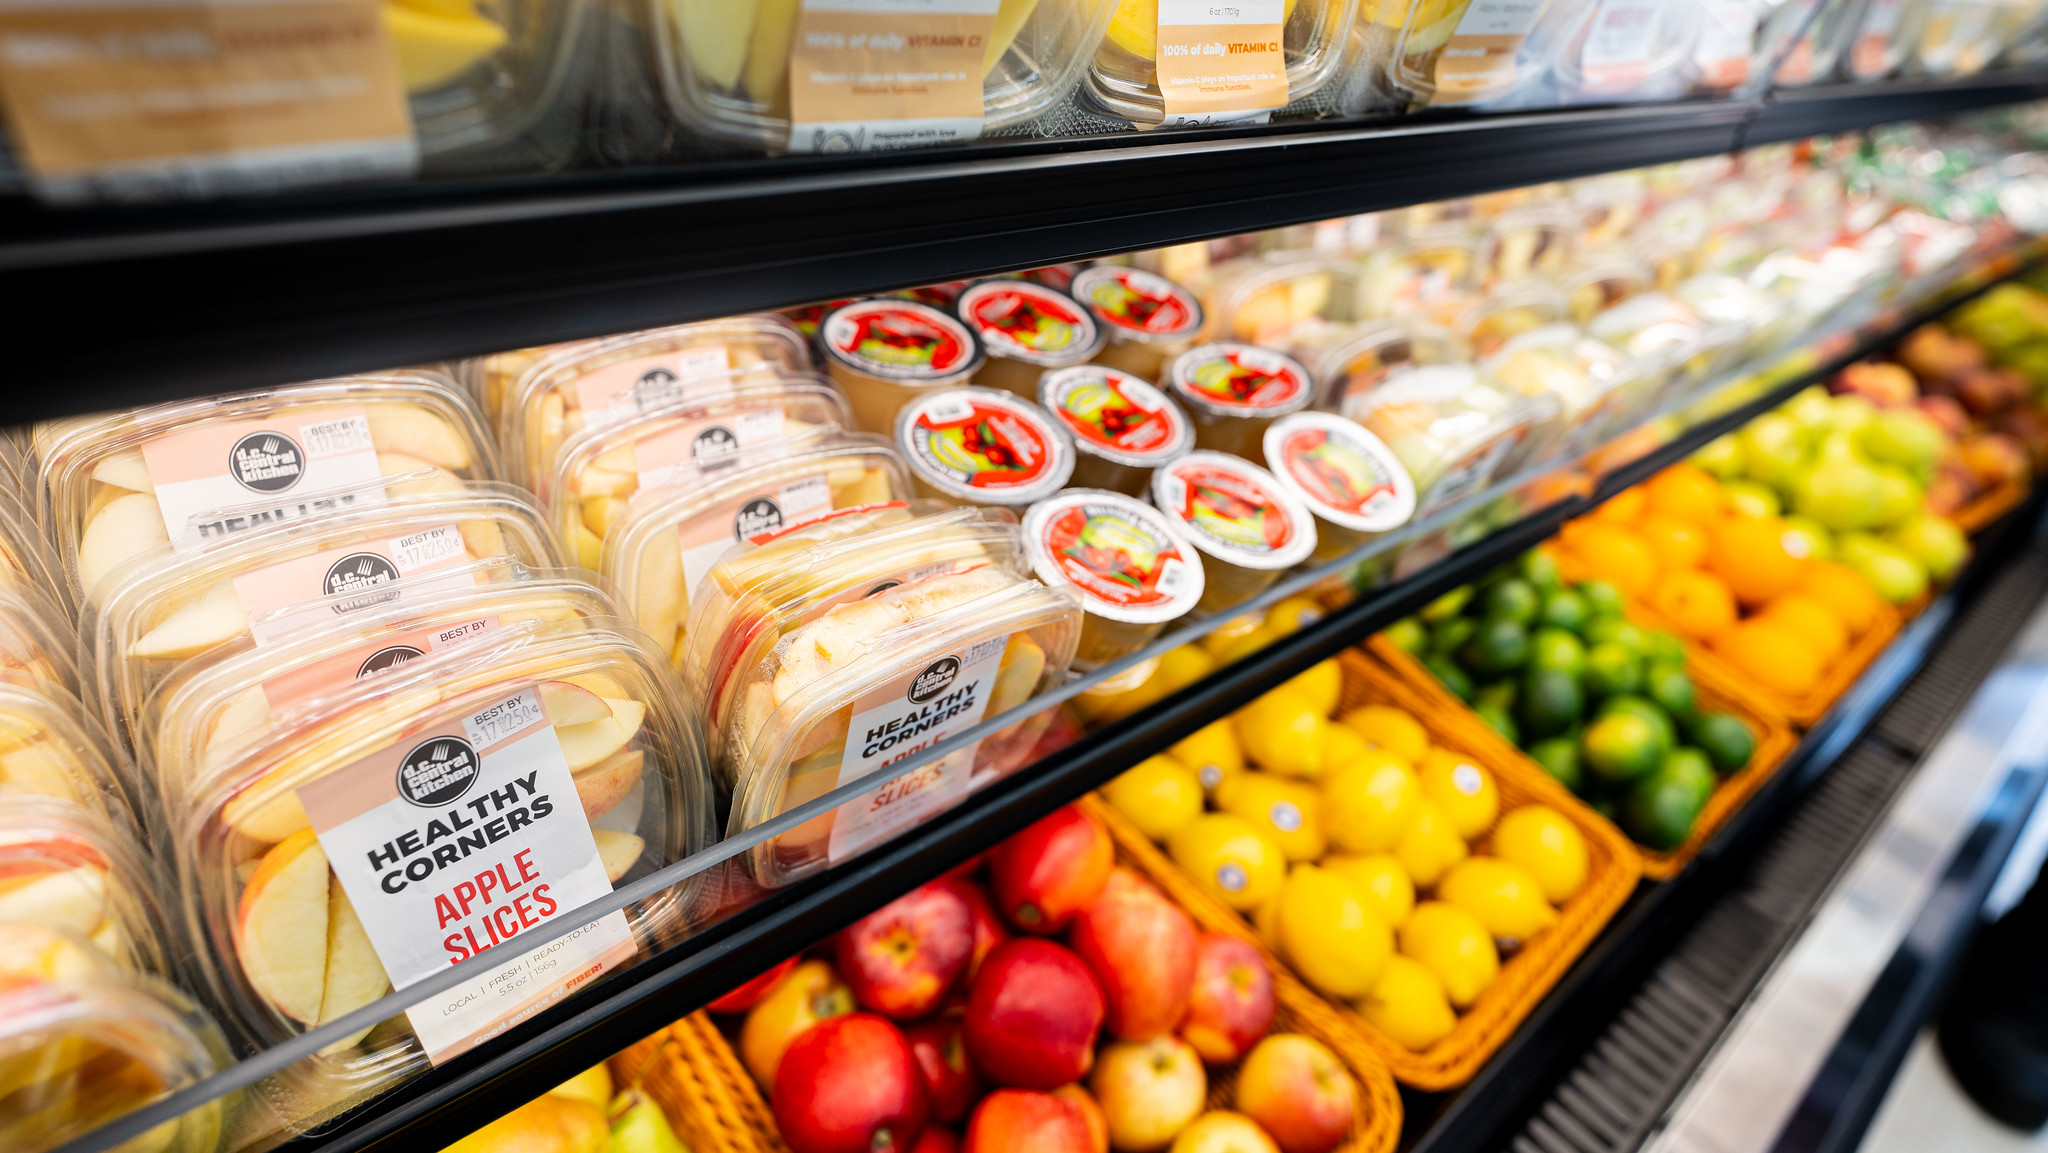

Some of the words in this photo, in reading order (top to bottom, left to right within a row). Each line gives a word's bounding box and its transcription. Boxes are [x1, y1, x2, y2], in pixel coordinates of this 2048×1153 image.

[848, 32, 867, 48] of
[869, 31, 905, 53] daily
[908, 33, 964, 48] VITAMIN
[1163, 45, 1188, 56] 100%
[1190, 43, 1202, 55] of
[1203, 42, 1226, 57] daily
[1228, 42, 1267, 54] VITAMIN
[1269, 42, 1278, 52] C!
[1170, 76, 1195, 85] Vitamin
[236, 446, 266, 460] d.c.
[238, 450, 297, 471] central
[240, 462, 300, 483] kitchen
[400, 532, 430, 548] BEST
[431, 528, 446, 538] BY
[330, 571, 360, 587] d.c.
[440, 625, 469, 642] BEST
[472, 620, 487, 632] BY
[912, 676, 954, 699] kitchen
[914, 666, 956, 692] central
[474, 704, 505, 726] BEST
[506, 696, 522, 710] BY
[866, 679, 980, 744] HEALTHY
[481, 722, 498, 741] 17
[862, 696, 976, 759] CORNERS
[402, 760, 436, 780] d.c.
[406, 750, 470, 790] central
[410, 764, 474, 801] kitchen
[367, 770, 538, 872] HEALTHY
[381, 795, 554, 895] CORNERS
[434, 847, 540, 930] APPLE
[443, 883, 558, 966] SLICES
[442, 992, 478, 1017] LOCAL
[488, 964, 523, 990] FRESH
[498, 982, 515, 997] 5.5
[515, 976, 528, 988] oz
[534, 959, 558, 978] 156g
[473, 1022, 507, 1046] Good
[508, 997, 550, 1025] source
[551, 985, 564, 1000] of
[565, 962, 603, 990] FIBER!
